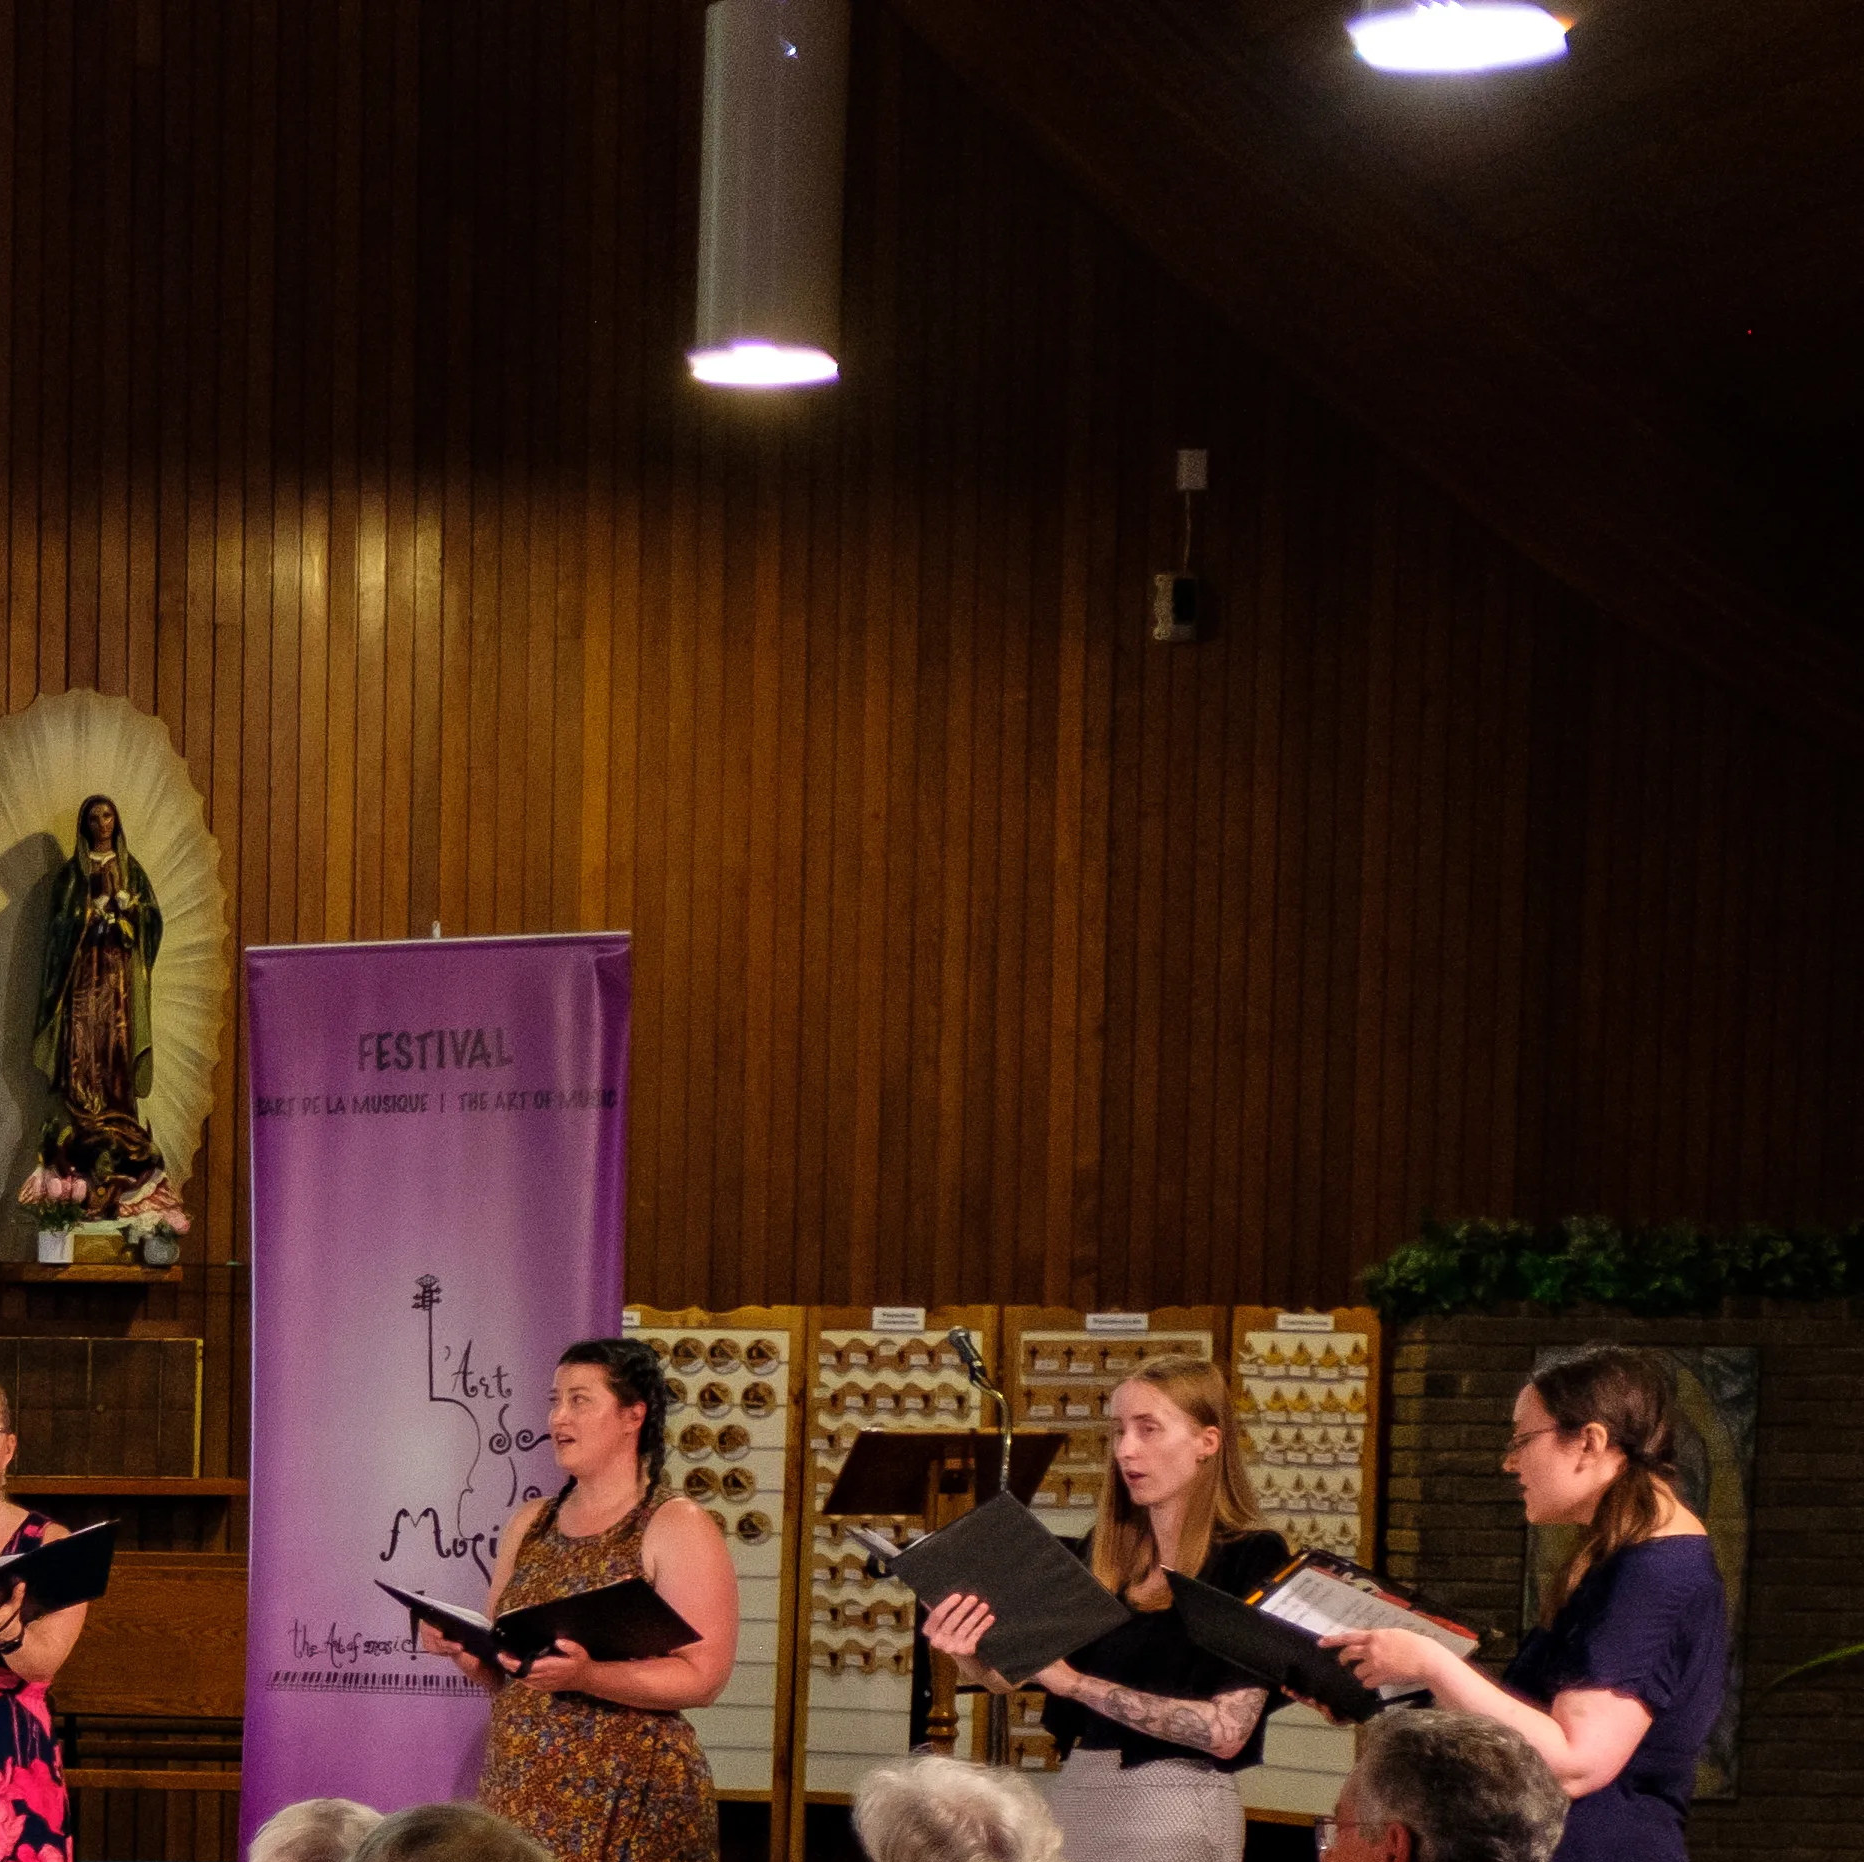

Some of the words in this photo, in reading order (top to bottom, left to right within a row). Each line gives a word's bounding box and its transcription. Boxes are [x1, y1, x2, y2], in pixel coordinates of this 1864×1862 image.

[357, 1027, 514, 1072] FESTIVAL
[326, 1094, 346, 1115] LA
[352, 1092, 429, 1115] MUSIQUE
[459, 1090, 487, 1112] THE
[495, 1089, 527, 1112] ART
[288, 1618, 321, 1659] the
